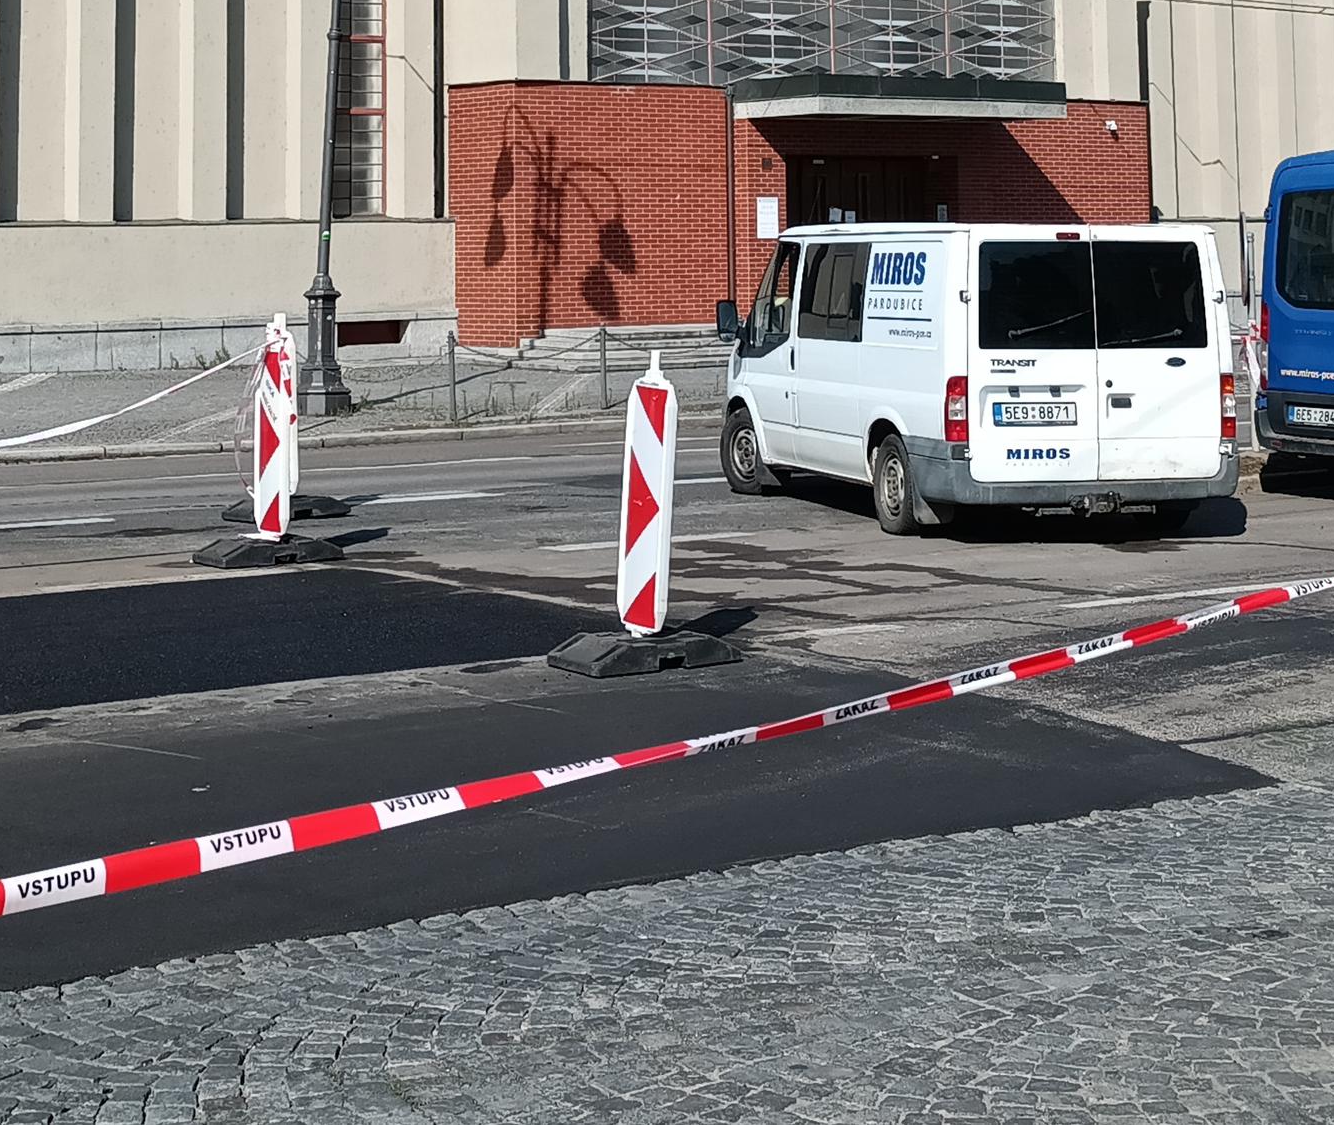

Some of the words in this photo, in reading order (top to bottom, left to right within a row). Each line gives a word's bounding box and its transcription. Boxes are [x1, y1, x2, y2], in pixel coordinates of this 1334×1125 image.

[870, 251, 927, 285] MIROS
[867, 297, 923, 311] PARDUBICE
[990, 358, 1037, 367] TRANSIT
[1005, 406, 1029, 420] 5E9
[1038, 406, 1070, 420] 8871
[1296, 408, 1313, 421] 6E5
[1006, 448, 1071, 460] MIROS
[383, 788, 450, 813] VSTUPU
[210, 825, 282, 854] VSTUPU
[17, 866, 96, 900] VSTUPU
